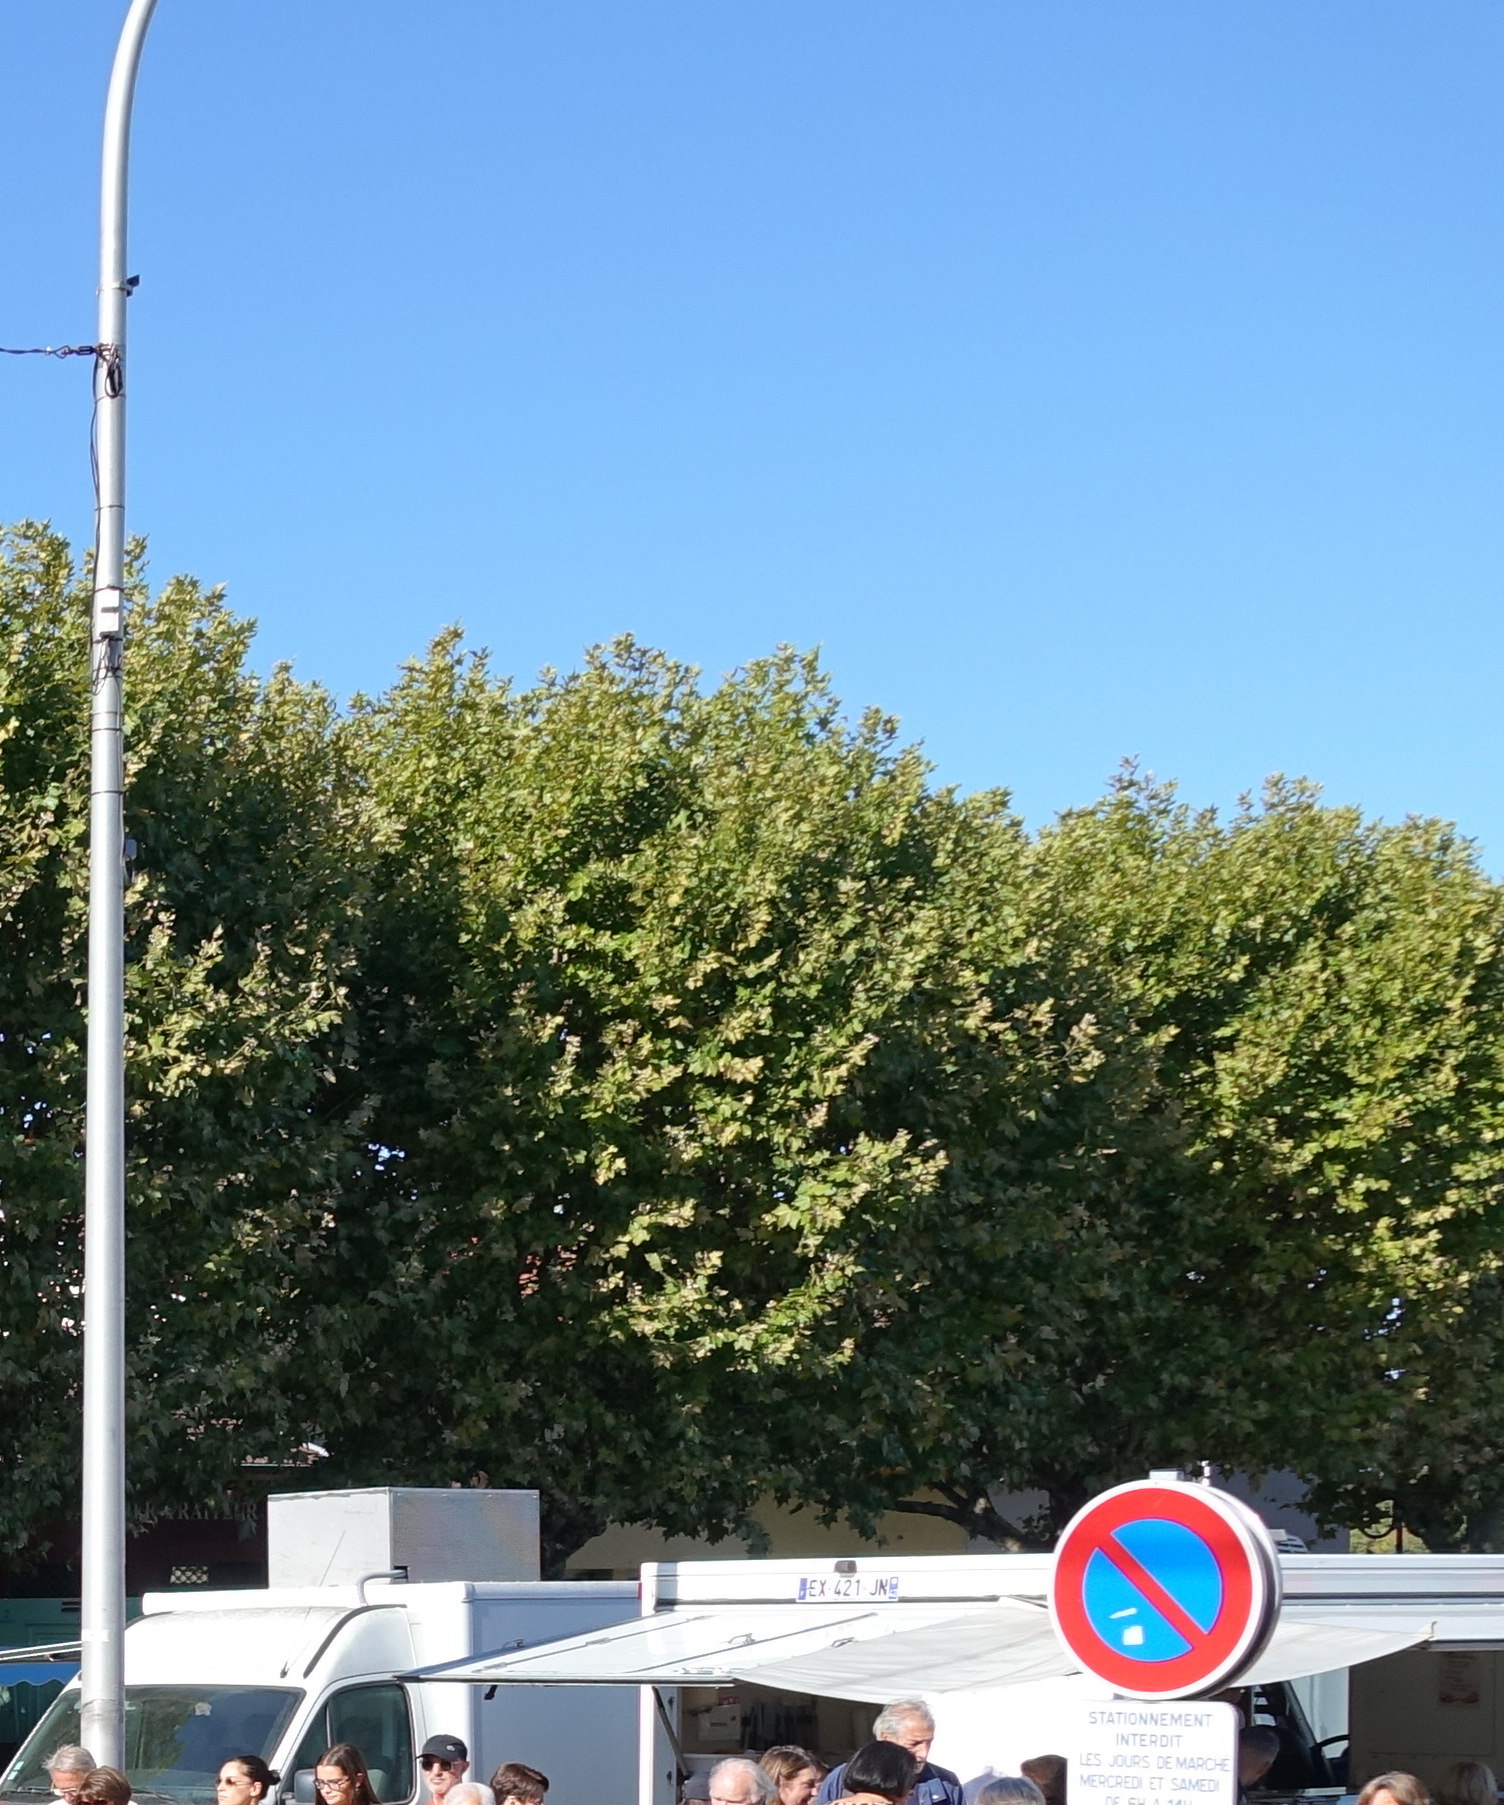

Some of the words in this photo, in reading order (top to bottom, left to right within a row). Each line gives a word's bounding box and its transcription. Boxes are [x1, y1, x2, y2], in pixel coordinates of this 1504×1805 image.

[1088, 1711, 1213, 1727] STATIONNEMENT
[1115, 1733, 1183, 1748] INTERDIT
[1079, 1752, 1102, 1767] LES
[1108, 1754, 1150, 1769] JOURS
[1157, 1756, 1173, 1770] DE
[1079, 1774, 1143, 1789] MERCREDI
[1149, 1776, 1164, 1790] ET
[1171, 1777, 1219, 1792] SAMEDI
